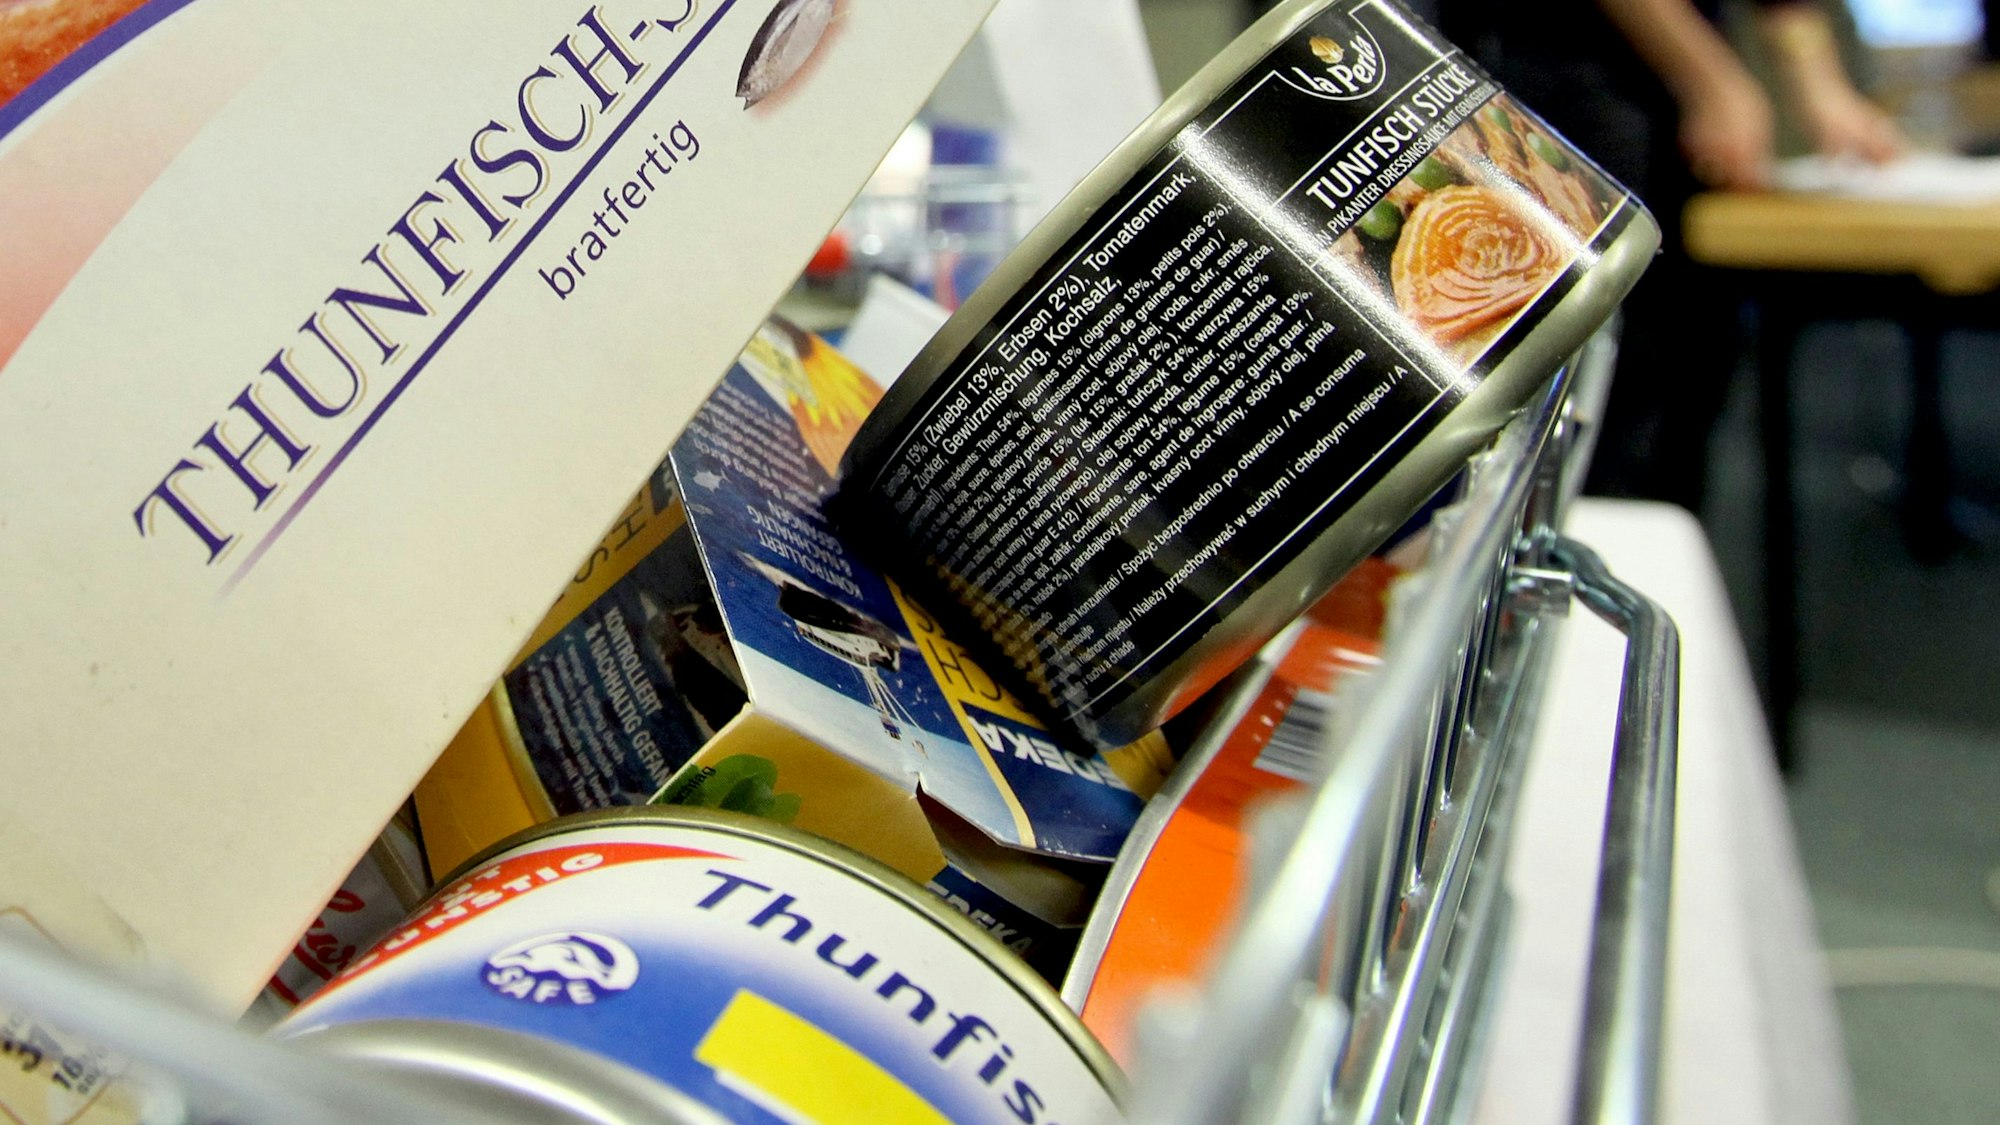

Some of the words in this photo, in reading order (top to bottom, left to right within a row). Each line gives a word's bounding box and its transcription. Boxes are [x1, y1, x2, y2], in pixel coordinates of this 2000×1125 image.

[1305, 104, 1426, 211] TUNFISCH
[1411, 63, 1477, 118] STÜCKE
[1326, 34, 1377, 92] Perla
[537, 118, 701, 301] bratfertig
[1326, 182, 1384, 235] PIKANTER
[1377, 123, 1450, 189] DRESSINGSAUCE
[1442, 111, 1461, 130] MIT
[905, 441, 929, 466] 15%
[923, 390, 972, 448] (Zwiebel
[967, 362, 1006, 395] 13%,
[997, 308, 1053, 363] Erbsen
[1048, 274, 1091, 312] 2%),
[1082, 168, 1197, 272] Tomatenmark,
[912, 453, 950, 490] Zucker,
[942, 347, 1051, 455] Gewürzmischung,
[1043, 275, 1123, 347] Kochsalz,
[941, 450, 982, 492] Ingrédients:
[975, 429, 1001, 452] Thon
[996, 409, 1023, 432] 54%,
[1017, 368, 1060, 410] legumes
[1057, 345, 1082, 369] 15%
[1079, 302, 1126, 349] (oignons
[1123, 278, 1155, 304] 13%,
[1150, 247, 1183, 280] petits
[1180, 224, 1206, 252] pois
[953, 489, 972, 507] soja,
[968, 467, 993, 491] sucre,
[987, 439, 1020, 468] épices,
[1016, 420, 1036, 440] sel,
[1031, 363, 1091, 424] épaississant
[1086, 333, 1122, 369] (farine
[1119, 318, 1137, 335] de
[1135, 280, 1176, 323] graines
[1173, 266, 1191, 283] de
[1189, 237, 1221, 270] guar)
[973, 490, 995, 511] 2%),
[990, 454, 1027, 493] rajčatový
[1023, 427, 1058, 462] protlak,
[1053, 398, 1082, 427] vinný
[1080, 376, 1108, 402] ocet,
[1104, 341, 1139, 378] sójový
[1137, 321, 1163, 346] olej,
[1159, 295, 1194, 322] voda,
[1190, 267, 1220, 294] cukr,
[1216, 238, 1249, 269] směs
[986, 502, 1007, 522] tuna
[1001, 485, 1026, 507] 54%,
[1049, 435, 1074, 458] 15%
[1069, 417, 1092, 440] (luk
[1089, 394, 1119, 419] 15%,
[1115, 358, 1153, 397] grašak
[1148, 340, 1171, 361] 2%
[1176, 275, 1237, 333] koncentrat
[1233, 244, 1275, 280] rajčica,
[989, 516, 1019, 547] sredstvo
[1015, 506, 1029, 521] za
[1025, 455, 1080, 510] zgušnjavanje
[1081, 406, 1131, 453] Składniki:
[1126, 368, 1170, 409] tuńczyk
[1165, 344, 1199, 371] 54%,
[1194, 296, 1245, 343] warzywa
[1241, 272, 1270, 297] 15%
[767, 499, 844, 556] GEFANGEN
[1005, 534, 1028, 557] winny
[1022, 526, 1035, 540] (z
[1031, 509, 1053, 530] wina
[1049, 466, 1100, 513] ryżowego),
[1096, 444, 1119, 467] olej
[1114, 413, 1154, 450] sojowy,
[1149, 384, 1186, 414] woda,
[1182, 349, 1221, 384] cukier,
[1217, 294, 1277, 351] mieszanka
[1012, 551, 1037, 576] (guma
[1032, 535, 1052, 558] guar
[1047, 525, 1060, 540] E
[1056, 508, 1080, 531] 412)
[1079, 454, 1137, 509] Ingrediente:
[1132, 438, 1154, 457] ton
[1149, 415, 1183, 441] 54%,
[1176, 374, 1220, 415] legume
[1218, 350, 1246, 375] 15%
[1243, 312, 1284, 353] (ceapă
[1281, 290, 1314, 315] 13%,
[1051, 568, 1074, 588] 2%),
[1070, 520, 1122, 574] paradajkový
[1118, 492, 1157, 529] pretlak,
[1151, 455, 1192, 494] kvasný
[1189, 433, 1216, 460] ocot
[1245, 369, 1283, 407] sójový
[1281, 348, 1308, 373] olej,
[1304, 320, 1335, 353] pitná
[1055, 612, 1080, 636] odmah
[1073, 574, 1121, 618] konzumirati
[1121, 539, 1159, 575] Spożyć
[1153, 482, 1223, 546] bezpośrednio
[1221, 468, 1239, 488] po
[1237, 424, 1285, 470] otwarciu
[1288, 408, 1303, 423] A
[1299, 395, 1317, 412] se
[1315, 348, 1367, 397] consuma
[1072, 494, 1128, 544] condimente,
[1123, 470, 1152, 495] sare,
[1149, 438, 1181, 471] agent
[1178, 425, 1195, 443] de
[1246, 343, 1281, 380] gumă
[1104, 617, 1133, 643] mjestu
[1132, 586, 1168, 617] Należy
[1164, 523, 1237, 594] przechowywać
[1233, 514, 1247, 528] w
[1246, 476, 1291, 518] suchym
[1294, 421, 1350, 473] chłodnym
[1346, 381, 1392, 425] miejscu
[1394, 365, 1409, 379] A
[746, 504, 846, 574] NACHHALTIG
[757, 528, 864, 602] KONTROLLIERT
[590, 635, 643, 735] NACHHALTIG
[603, 605, 664, 716] KONTROLLIERT
[966, 714, 1134, 794] EDEKA
[1108, 640, 1136, 664] chlade
[486, 964, 597, 1005] SAFE
[695, 868, 1060, 1125] Thunfis
